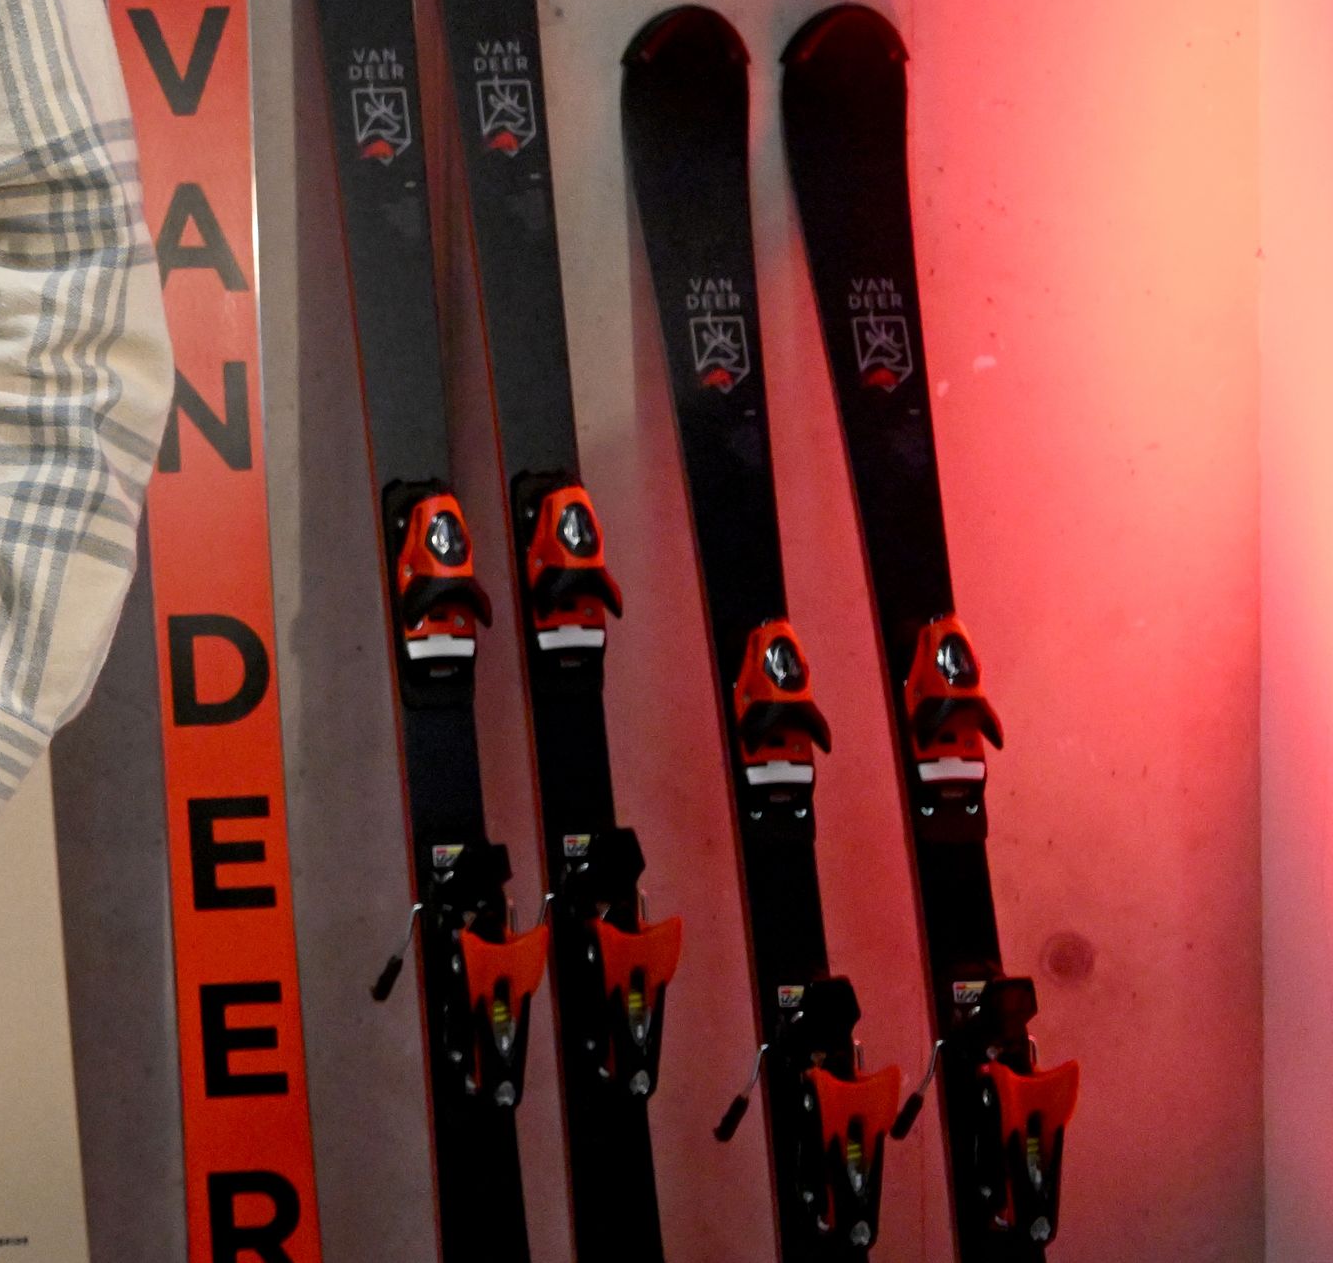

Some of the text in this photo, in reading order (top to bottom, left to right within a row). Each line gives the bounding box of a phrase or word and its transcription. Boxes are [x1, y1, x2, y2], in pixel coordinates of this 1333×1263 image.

[352, 47, 397, 64] VAN
[477, 39, 521, 56] VAN
[348, 63, 405, 81] DEER
[473, 55, 528, 73] DEER
[126, 5, 253, 474] VAN
[689, 277, 733, 292] VAN
[851, 277, 895, 292] VAN
[686, 292, 741, 310] DEER
[847, 292, 903, 310] DEER
[167, 613, 302, 1263] DEER
